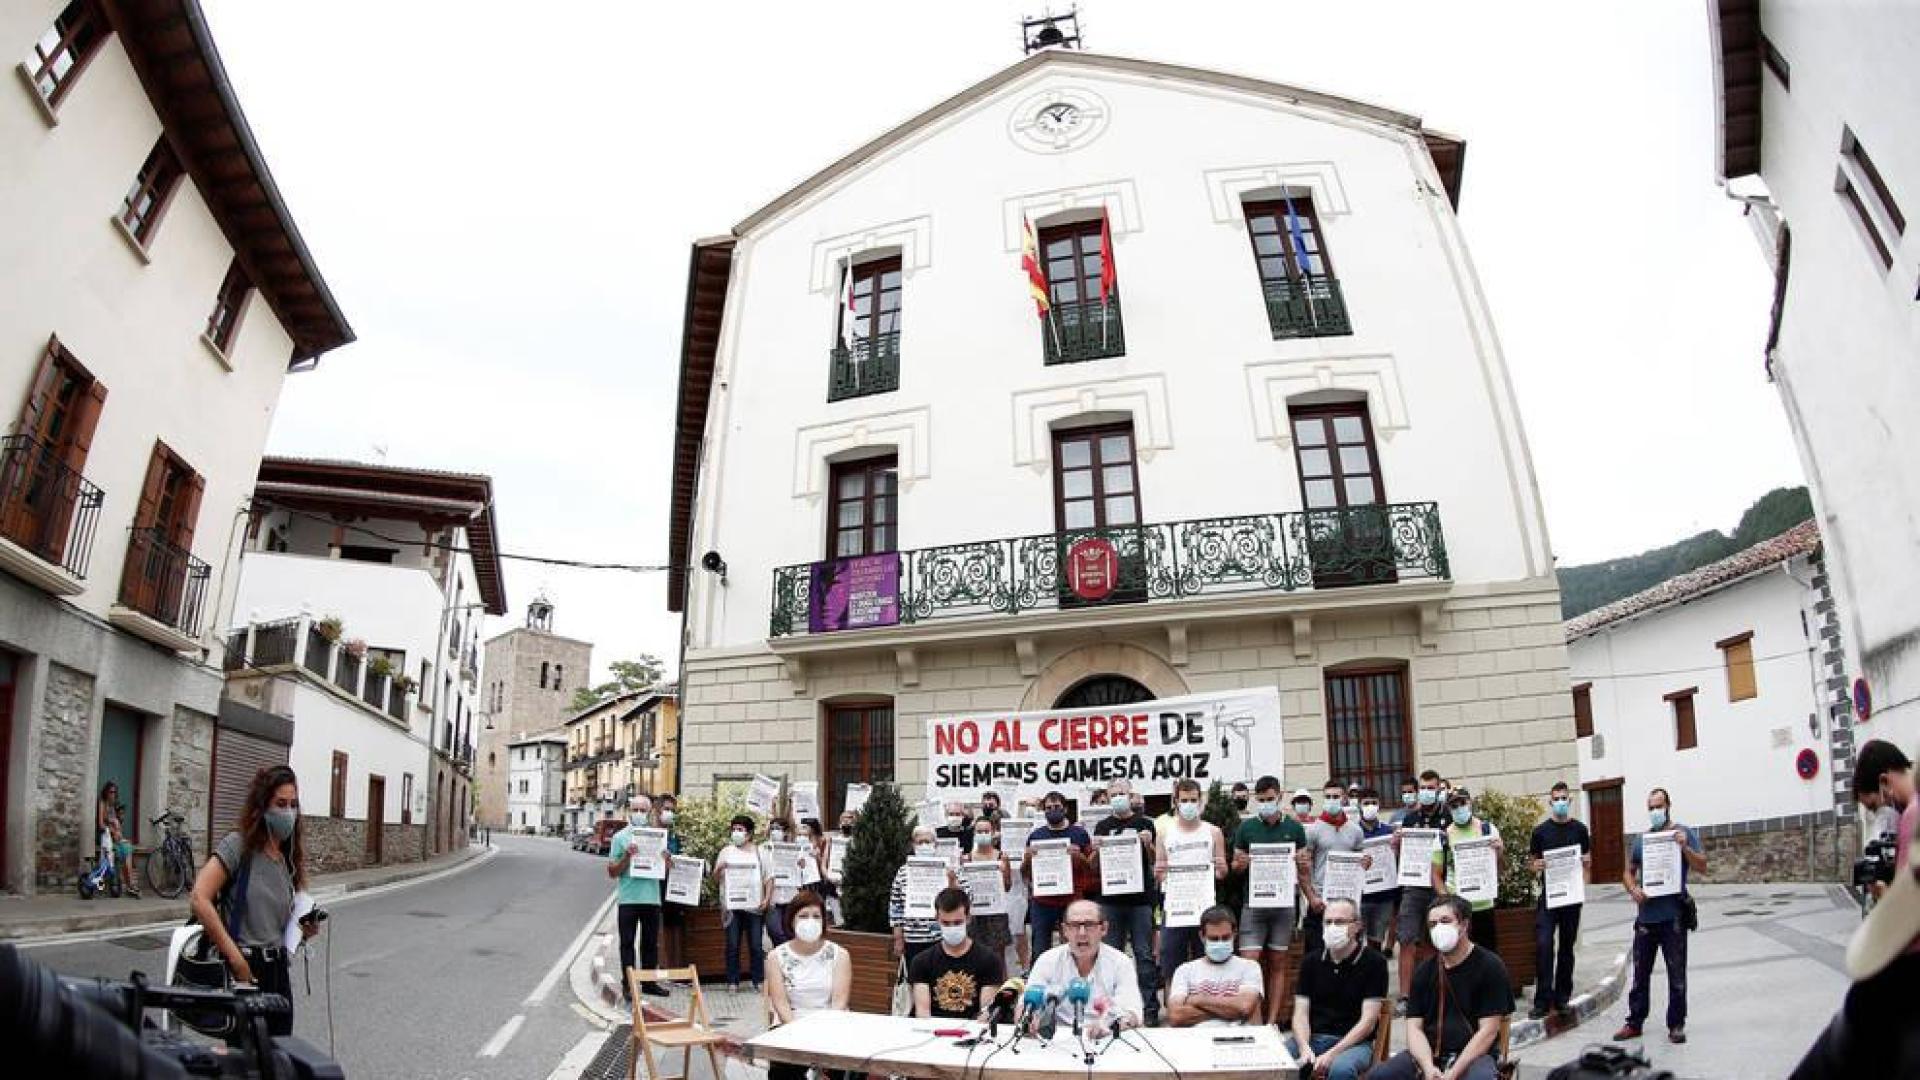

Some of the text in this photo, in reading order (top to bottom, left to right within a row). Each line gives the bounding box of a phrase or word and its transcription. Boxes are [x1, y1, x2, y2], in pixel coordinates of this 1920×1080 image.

[934, 712, 1206, 755] NO AL CIERRE DE
[935, 752, 1211, 788] SIEMENS GAMESA AOIZ
